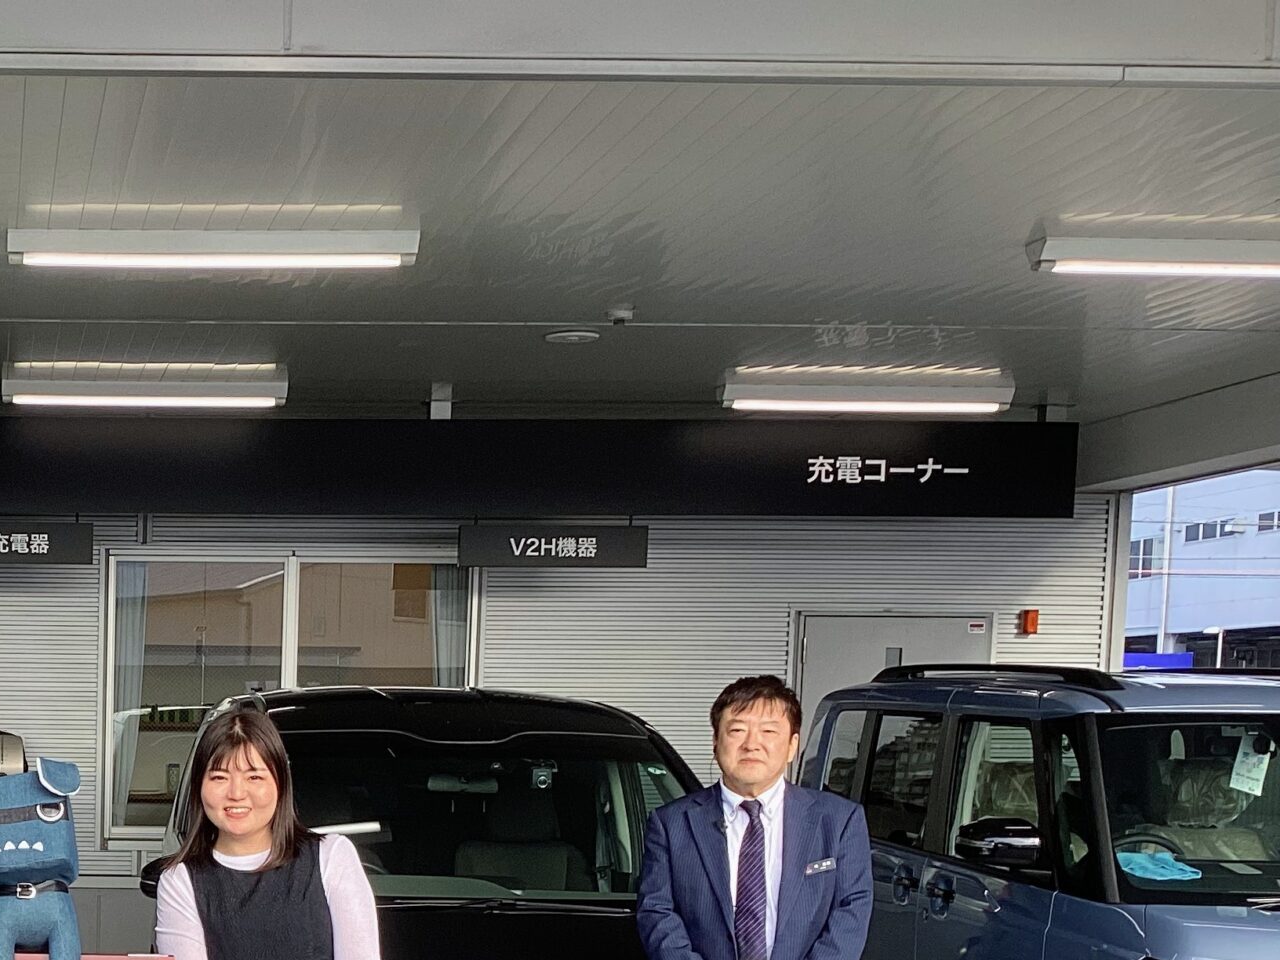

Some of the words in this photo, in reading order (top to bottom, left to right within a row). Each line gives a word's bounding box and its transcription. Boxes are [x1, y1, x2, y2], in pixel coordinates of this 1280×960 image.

[806, 455, 970, 484] 充電コーナー
[509, 537, 598, 558] V2H機器
